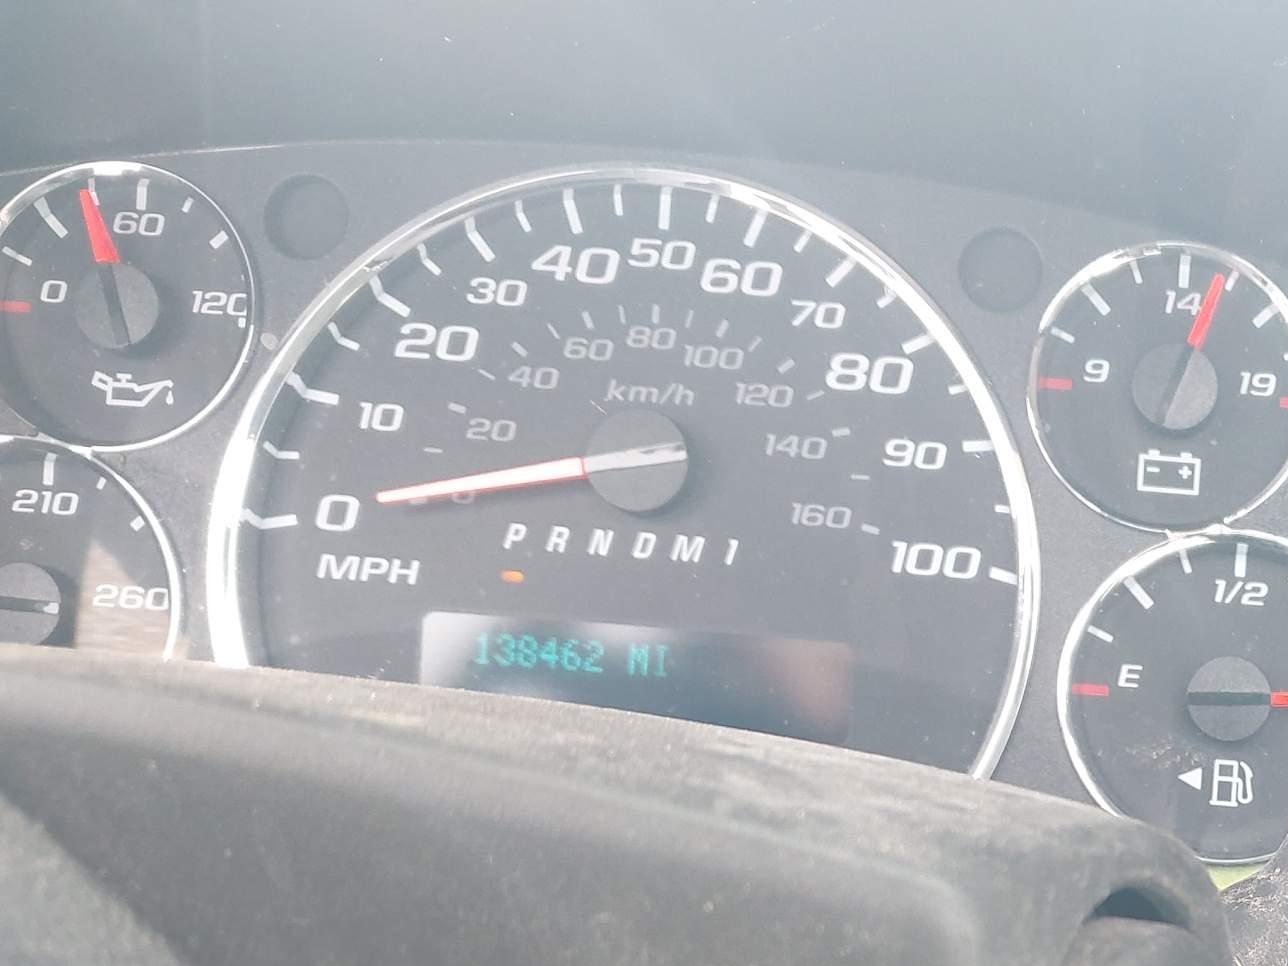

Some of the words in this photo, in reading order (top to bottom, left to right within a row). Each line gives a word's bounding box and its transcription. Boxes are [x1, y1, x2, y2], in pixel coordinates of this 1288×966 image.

[113, 211, 165, 236] 60
[531, 245, 620, 284] 40
[628, 238, 697, 270] 50
[40, 279, 68, 303] 0
[700, 258, 783, 297] 60
[192, 290, 248, 316] 120
[465, 277, 528, 307] 30
[1165, 290, 1202, 316] 14
[791, 299, 846, 329] 70
[394, 323, 480, 362] 20
[563, 336, 614, 361] 60
[626, 326, 677, 350] 80
[684, 345, 744, 370] 100
[1082, 358, 1111, 383] 9
[508, 365, 559, 390] 40
[825, 353, 914, 395] 80
[1239, 371, 1278, 397] 19
[604, 379, 695, 406] km/h
[735, 382, 794, 408] 120
[359, 401, 404, 432] 10
[465, 417, 517, 442] 20
[765, 433, 828, 460] 140
[882, 438, 948, 470] 90
[12, 489, 79, 515] 210
[315, 494, 360, 532] 0
[790, 502, 852, 529] 160
[315, 554, 420, 585] MPH
[891, 541, 982, 579] 100
[92, 584, 169, 611] 260
[1213, 579, 1269, 606] 1/2
[472, 631, 604, 673] 138462
[627, 643, 671, 677] MI
[1117, 664, 1143, 688] E
